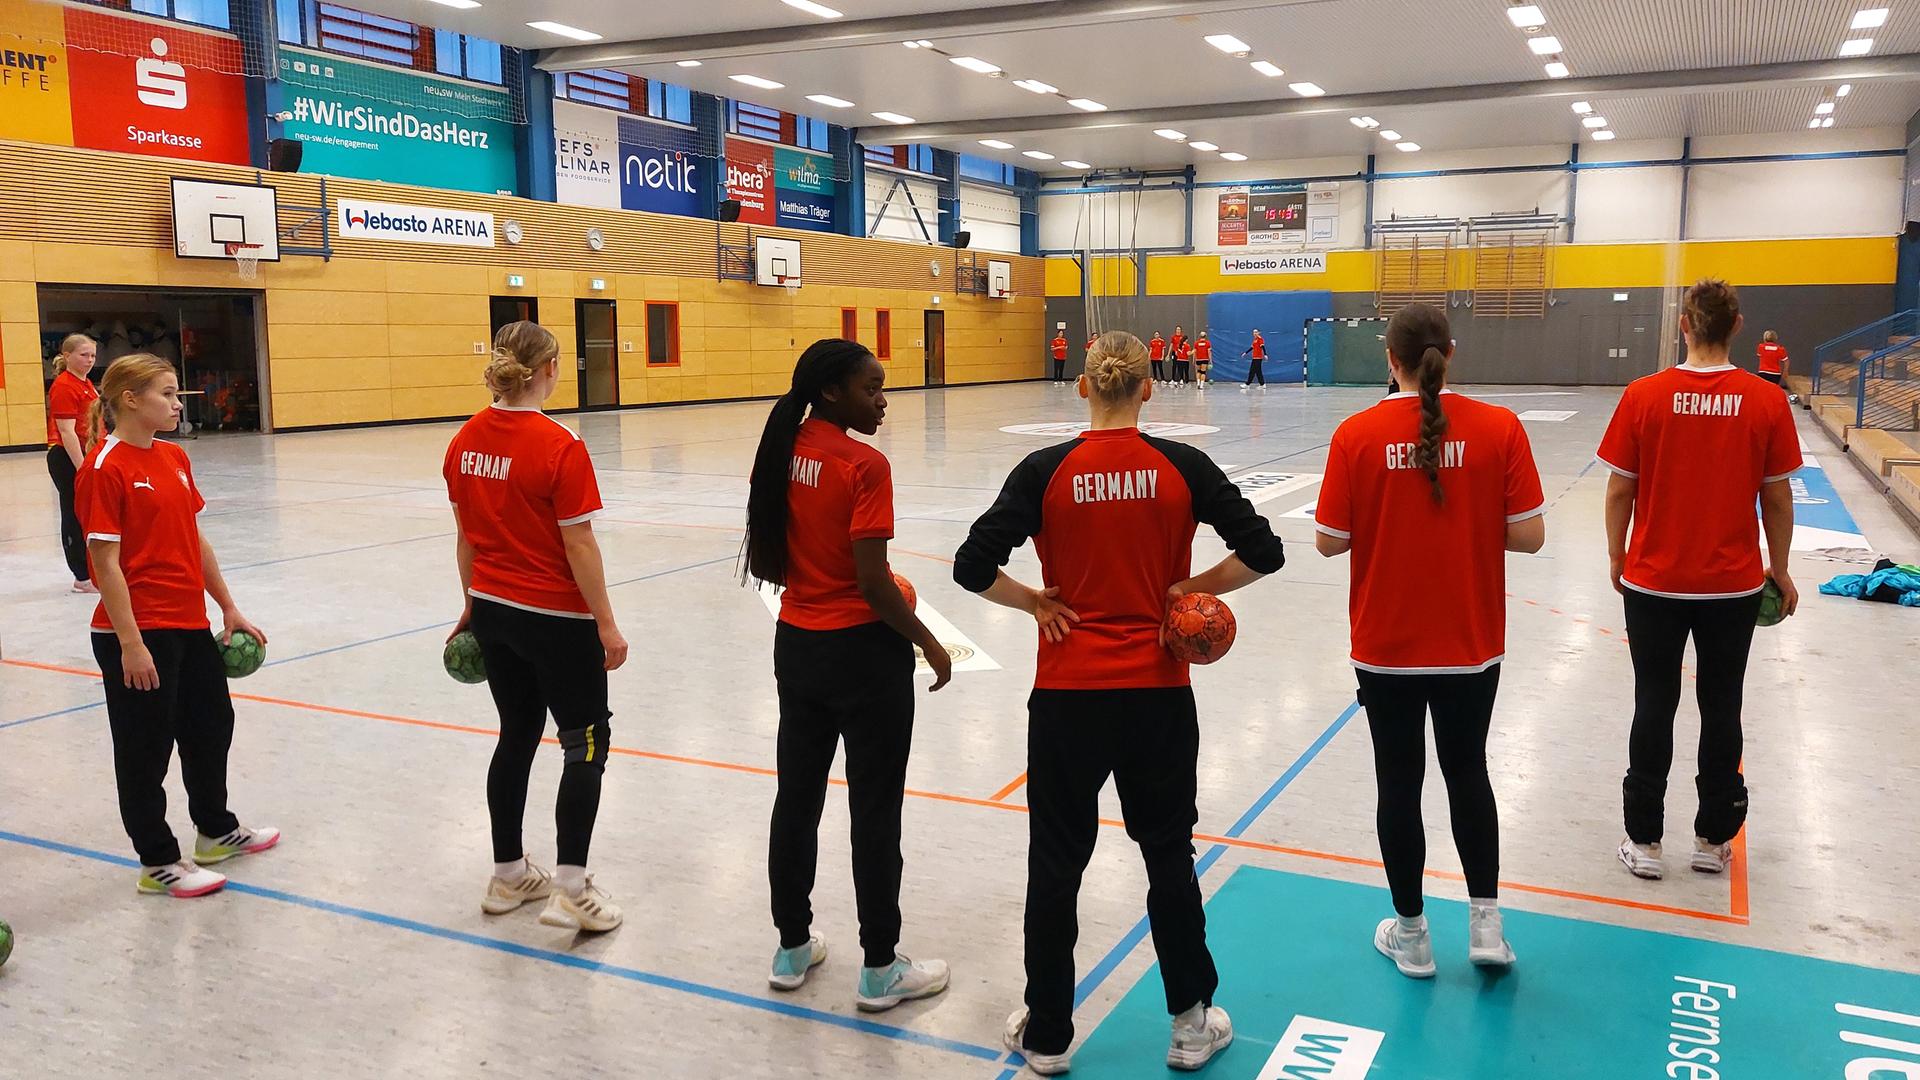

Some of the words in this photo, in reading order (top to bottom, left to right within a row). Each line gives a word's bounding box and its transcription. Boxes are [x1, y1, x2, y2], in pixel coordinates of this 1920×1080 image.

[0, 49, 47, 72] ENT
[294, 96, 489, 150] #WirSindDasHerz
[127, 126, 202, 149] Sparkasse
[294, 131, 380, 151] neu-sw.de/engagement
[560, 155, 611, 175] LINAR
[727, 165, 764, 190] thera
[780, 200, 809, 215] Matthias
[810, 204, 830, 220] Träger
[345, 208, 428, 233] Webasto
[432, 217, 489, 238] ARENA
[1224, 259, 1277, 271] Webasto
[1279, 257, 1322, 269] ARENA
[1672, 392, 1743, 417] GERMANY
[1385, 440, 1466, 470] GERNY
[1072, 469, 1158, 504] GERMANY
